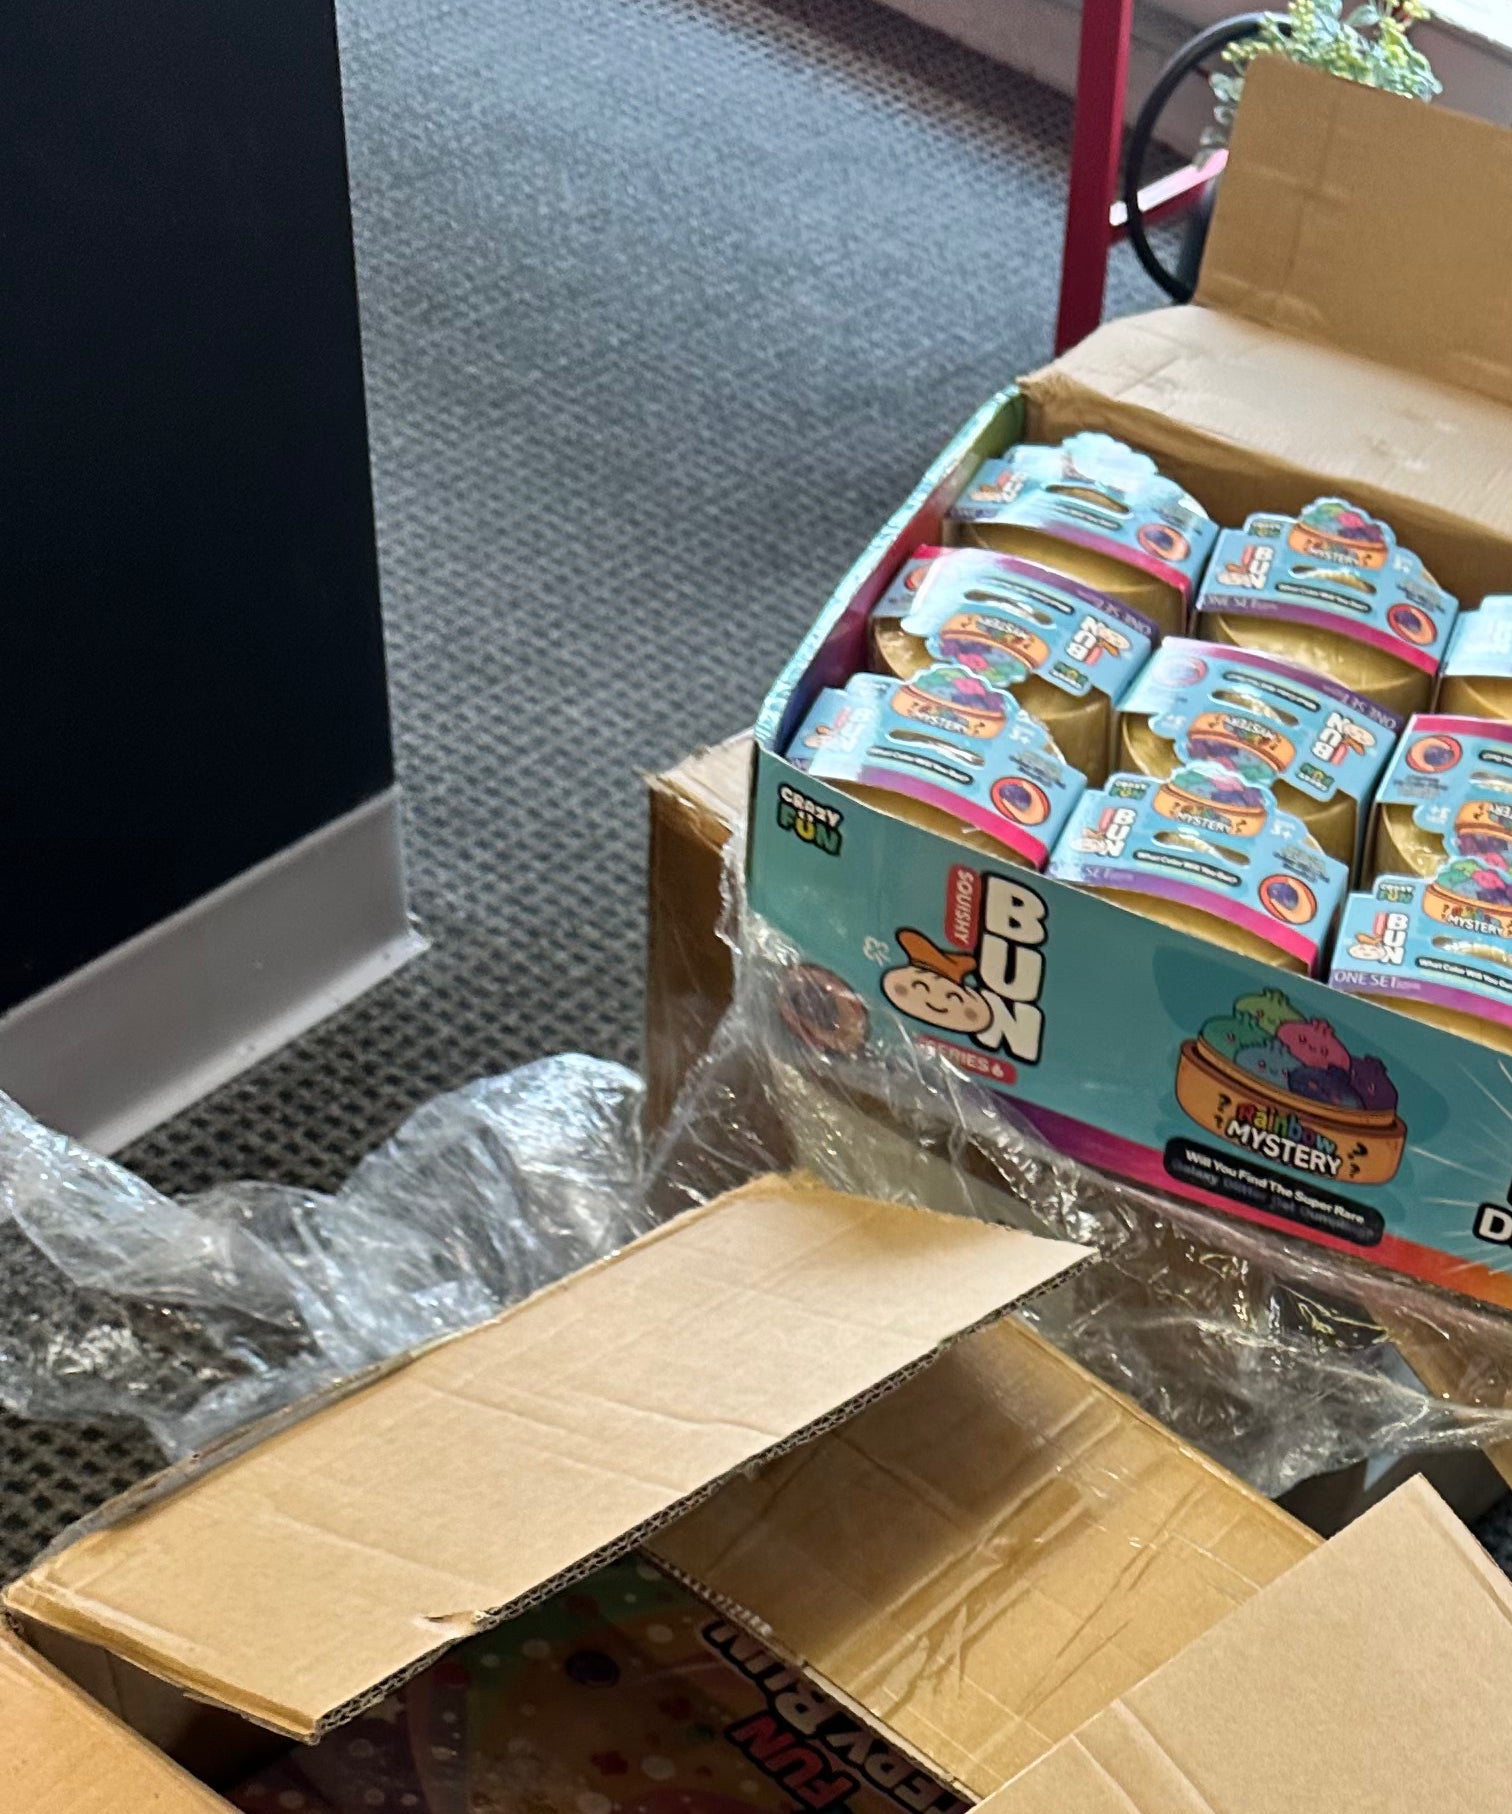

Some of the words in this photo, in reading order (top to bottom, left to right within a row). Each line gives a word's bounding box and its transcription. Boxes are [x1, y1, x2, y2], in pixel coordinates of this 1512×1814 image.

[776, 806, 842, 856] FUN
[777, 782, 843, 829] CRAZY
[952, 868, 976, 944] SQUISHY
[1448, 915, 1504, 936] MYSTERY
[1380, 912, 1410, 965] BUN
[972, 871, 1048, 1066] BUN
[1334, 971, 1367, 986] ONE
[1225, 1120, 1342, 1176] MYSTERY
[1235, 1100, 1336, 1153] Rainbow
[1185, 1148, 1213, 1169] Will
[1213, 1158, 1237, 1178] You
[1238, 1167, 1269, 1188] Find
[1269, 1179, 1294, 1199] The
[1294, 1190, 1334, 1213] Super
[1333, 1204, 1366, 1225] Rare
[722, 1709, 861, 1811] FUN
